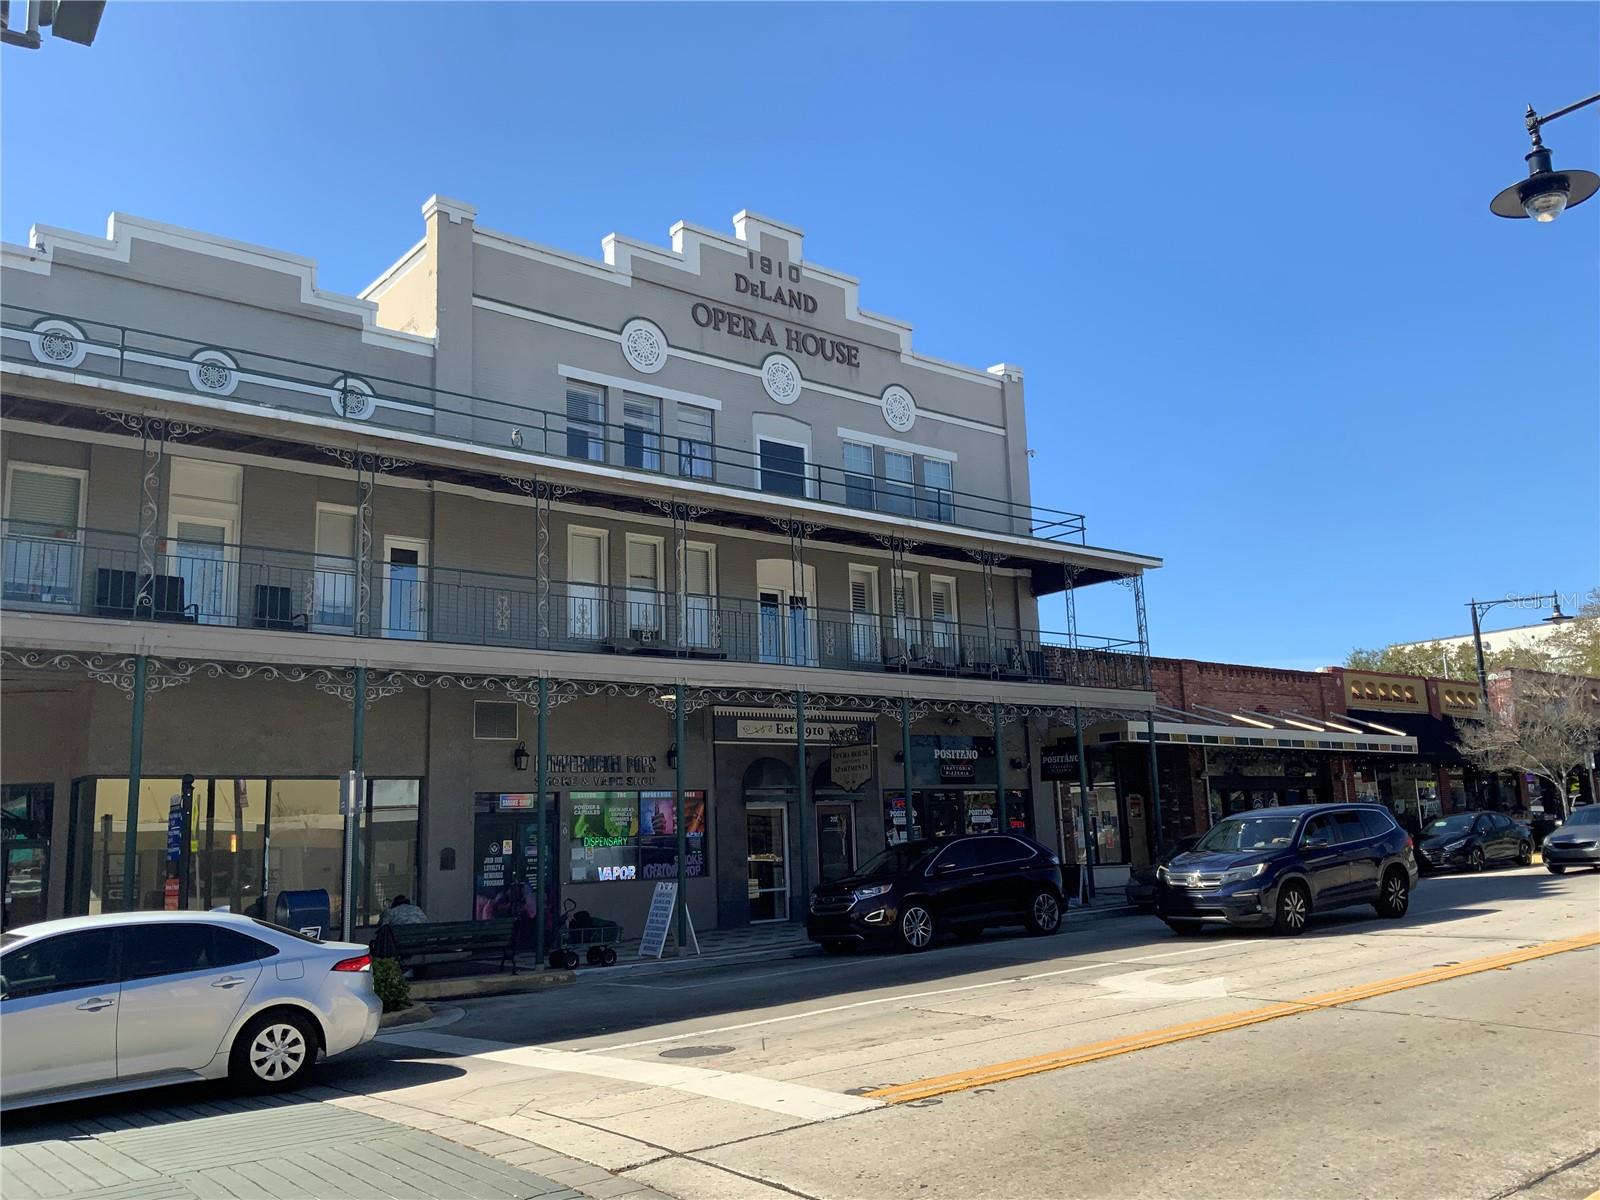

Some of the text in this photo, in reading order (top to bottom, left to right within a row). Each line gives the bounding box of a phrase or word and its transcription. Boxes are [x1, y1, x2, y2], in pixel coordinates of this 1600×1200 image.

[749, 251, 801, 284] 1910
[691, 302, 860, 368] OPERA HOUSE
[775, 723, 824, 738] Est. 910
[934, 749, 978, 760] POSITANO
[583, 836, 628, 847] DISPENSARY
[598, 865, 636, 881] VAPOR
